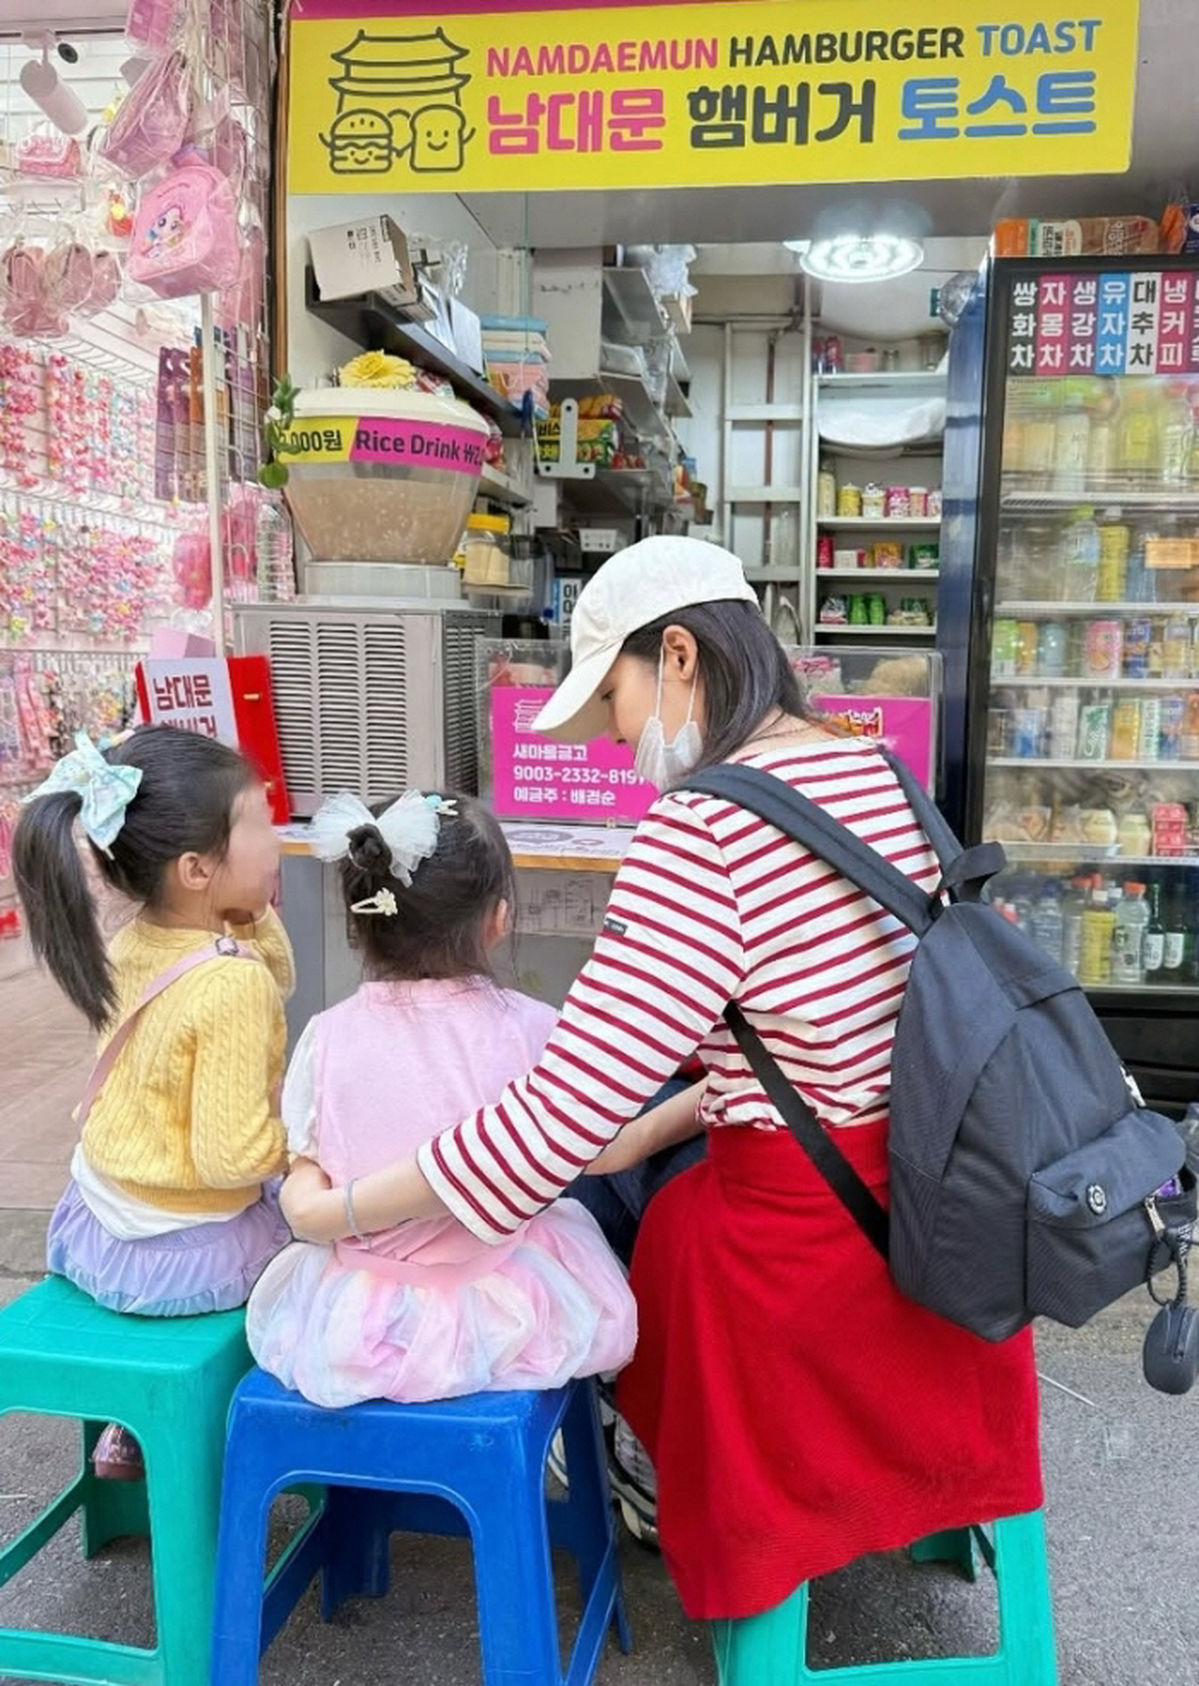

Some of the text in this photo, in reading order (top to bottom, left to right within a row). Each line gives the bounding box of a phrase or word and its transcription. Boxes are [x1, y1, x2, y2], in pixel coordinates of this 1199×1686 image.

[486, 19, 1102, 78] NAMDAEMUN HAMBURGER TOAST
[487, 70, 1097, 155] 남대문 햄버거 토스트
[1010, 281, 1037, 368] 쌍화차
[1039, 281, 1067, 368] 자몽차
[1069, 280, 1096, 368] 생강차
[1099, 280, 1126, 367] 유자차
[1130, 279, 1156, 366] 대추차
[1159, 279, 1187, 366] 냉커피
[356, 431, 404, 453] Rice
[411, 435, 460, 459] Drink
[153, 674, 213, 711] 남대문
[513, 744, 588, 761] 새마을금고
[514, 787, 558, 803] 예금주
